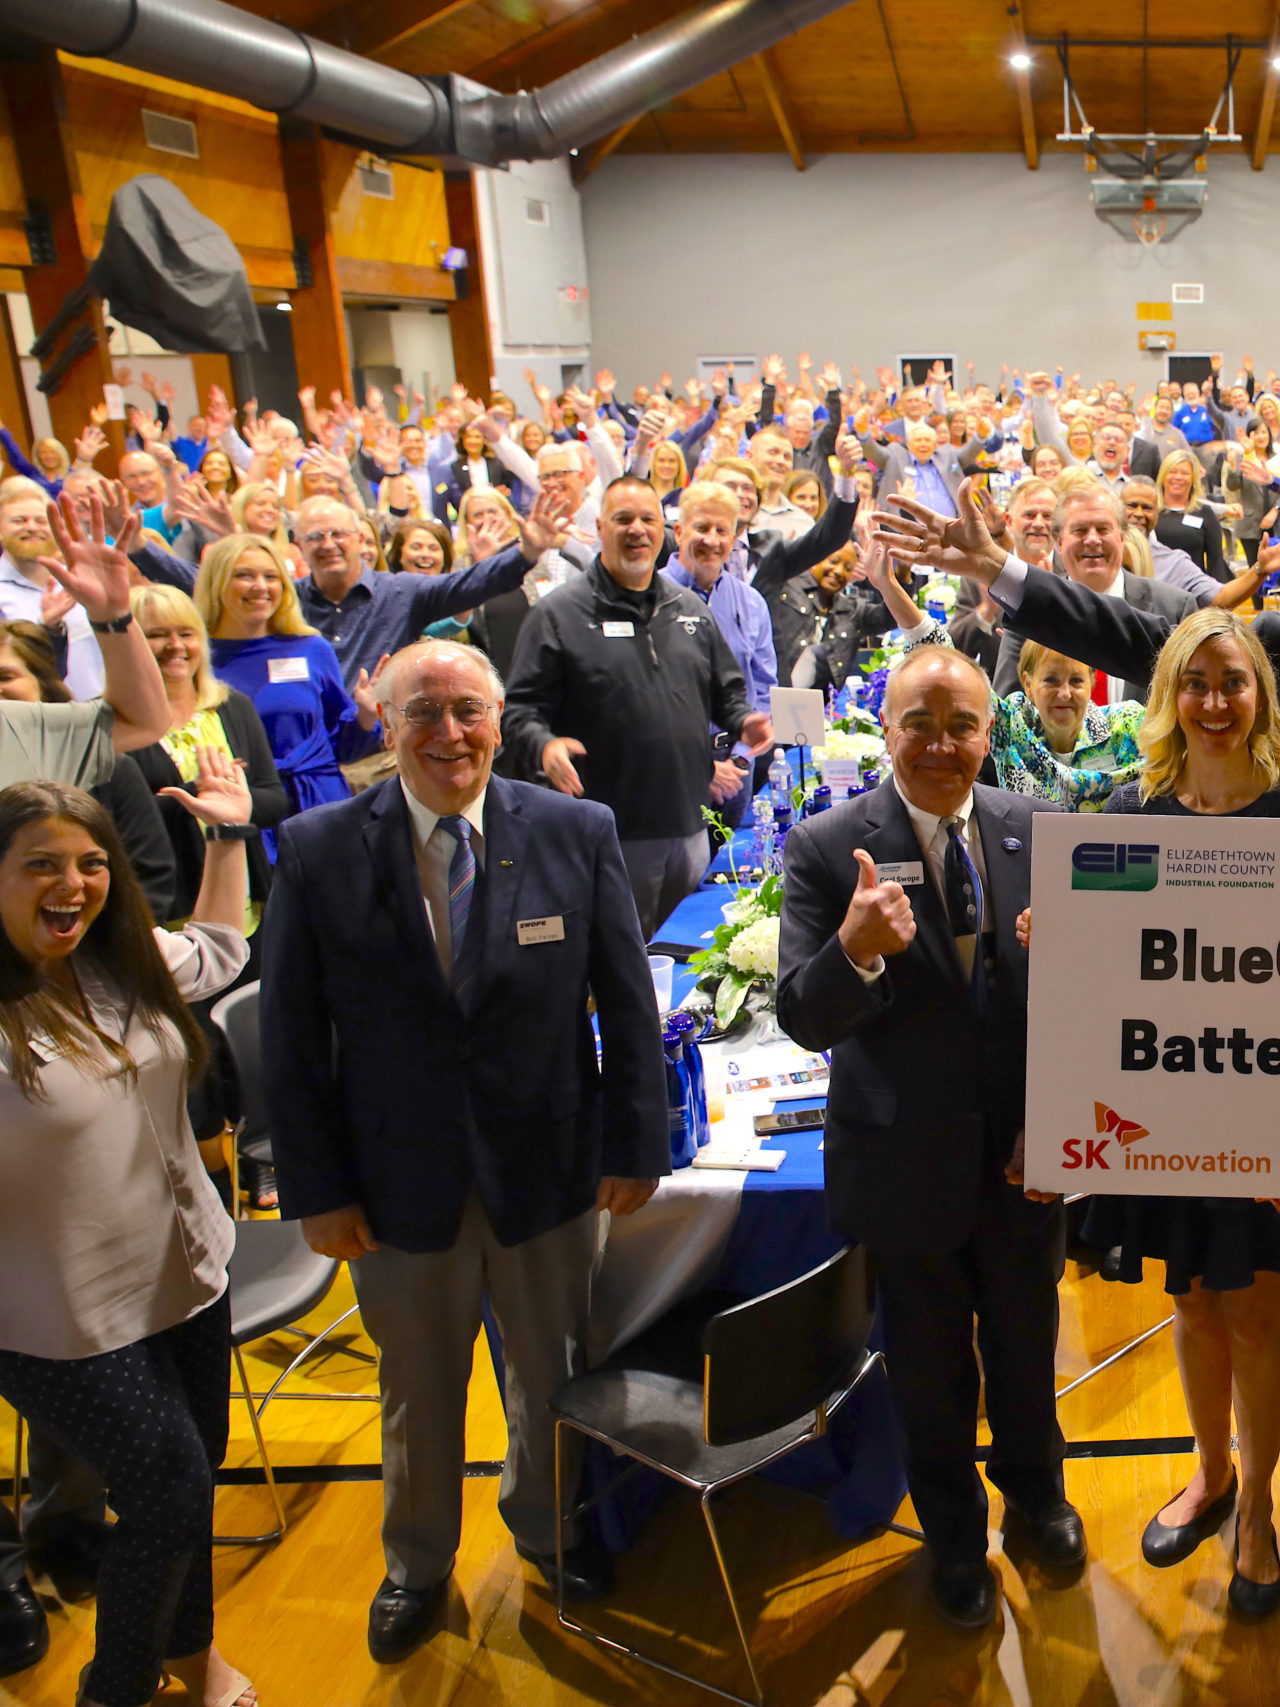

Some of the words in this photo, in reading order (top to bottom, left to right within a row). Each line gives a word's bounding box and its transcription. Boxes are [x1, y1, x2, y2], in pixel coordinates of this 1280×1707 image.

[1167, 849, 1276, 862] ELIZABETHTOWN
[1166, 863, 1217, 874] HARDIN
[1220, 864, 1275, 875] COUNTY
[896, 875, 920, 883] Swope
[1166, 879, 1216, 888] INDUSTRIAL
[1218, 880, 1275, 889] FOUNDATION
[1061, 1138, 1111, 1170] SK
[1124, 1147, 1271, 1173] innovation
